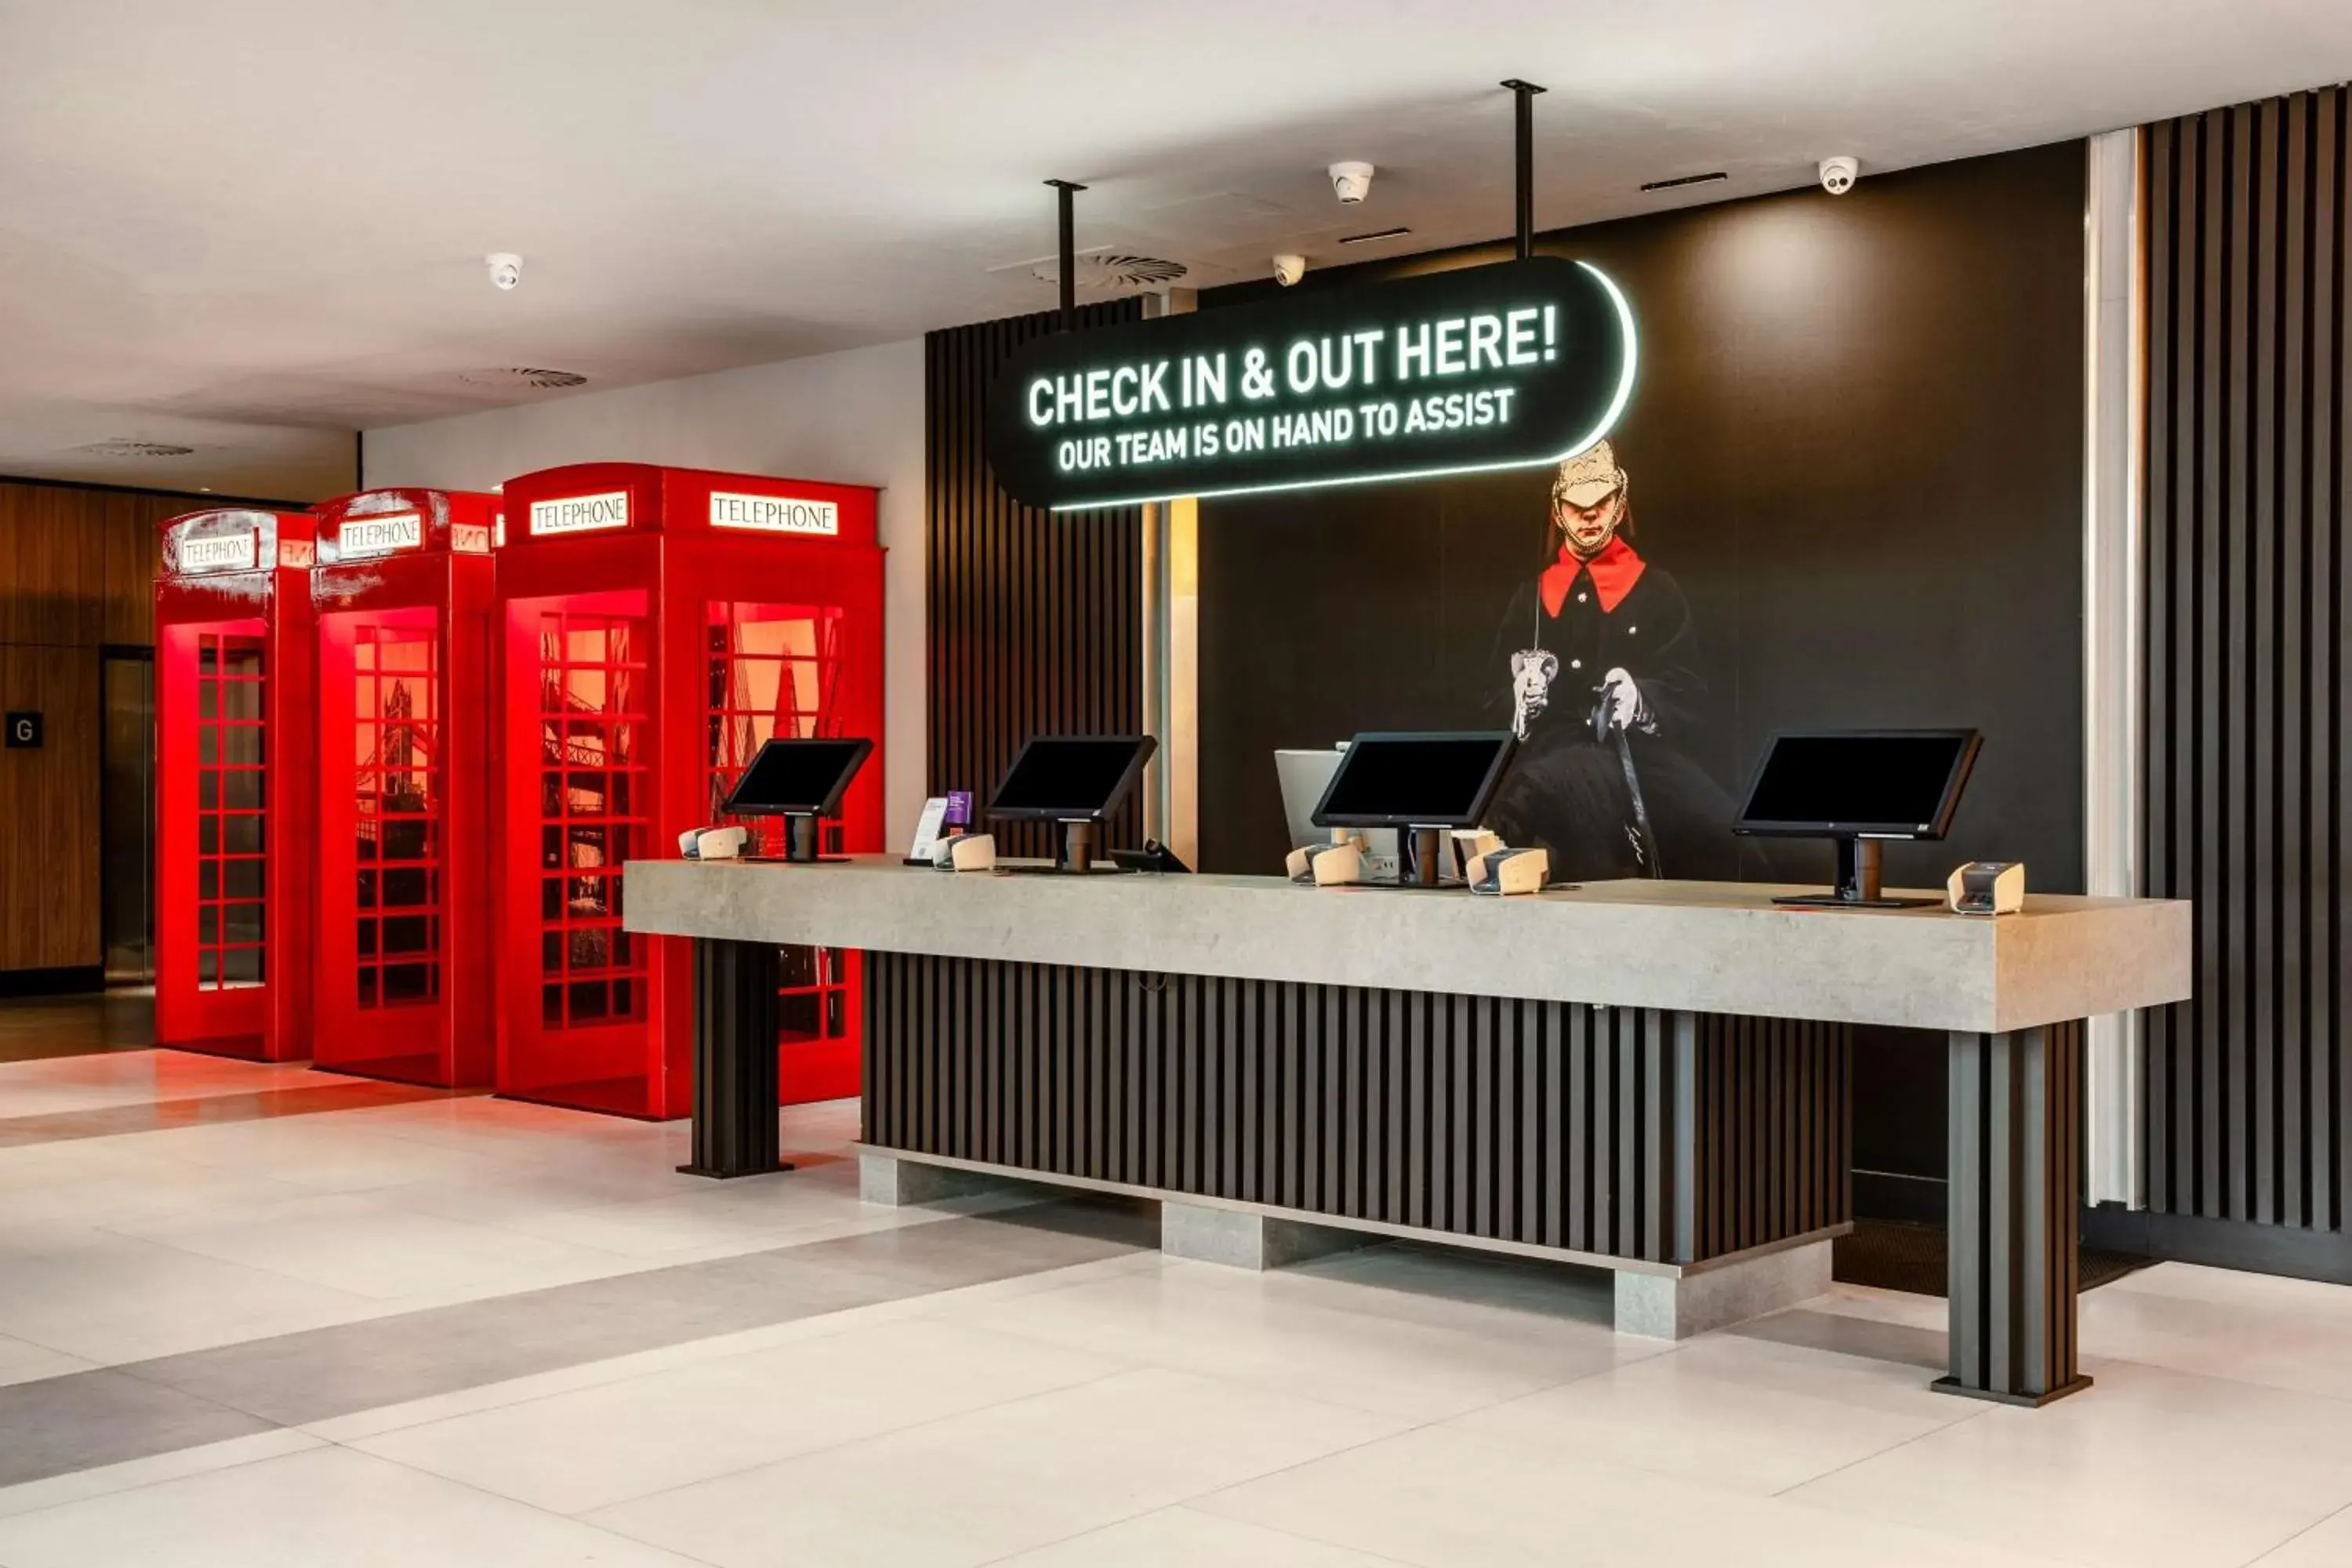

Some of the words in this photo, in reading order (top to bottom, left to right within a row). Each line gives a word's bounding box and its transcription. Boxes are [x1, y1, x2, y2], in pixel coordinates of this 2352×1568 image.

[1029, 361, 1171, 426] CHECK
[1181, 352, 1228, 408] IN
[1240, 347, 1276, 401] &
[1287, 329, 1385, 394] OUT
[1397, 304, 1557, 380] HERE!
[1058, 436, 1111, 472] OUR
[1115, 426, 1188, 465] TEAM
[1193, 423, 1220, 457] IS
[1225, 417, 1265, 453] ON
[1272, 408, 1354, 448] HAND
[1359, 401, 1399, 438] TO
[1403, 387, 1516, 434] ASSIST
[535, 497, 625, 529] TELEPHONE
[714, 497, 832, 529] TELEPHONE
[343, 520, 419, 548] TELEPHONE
[16, 720, 33, 741] G
